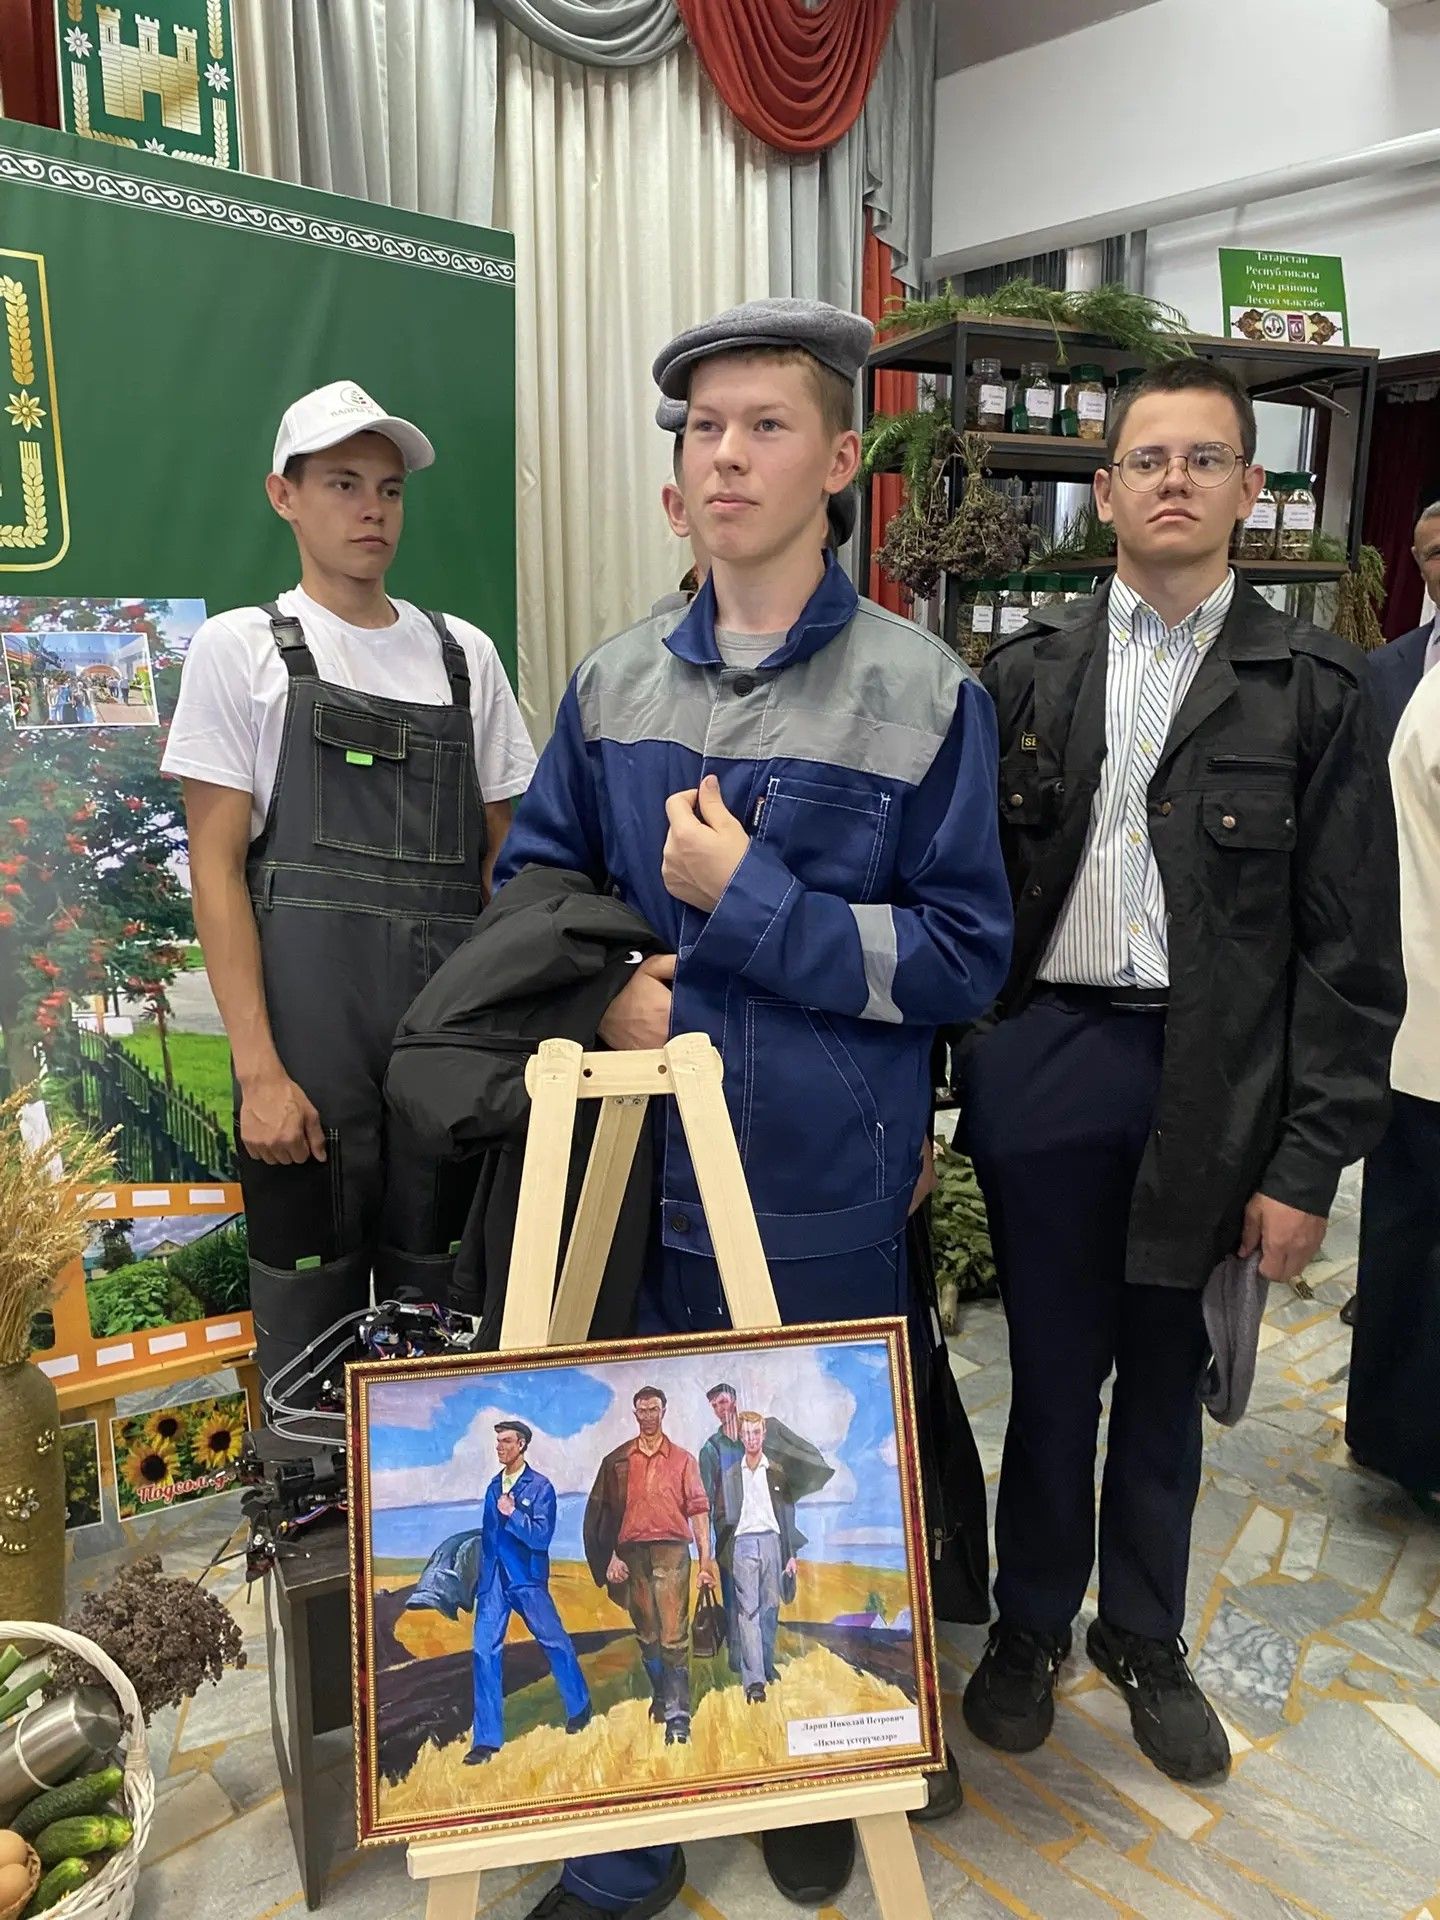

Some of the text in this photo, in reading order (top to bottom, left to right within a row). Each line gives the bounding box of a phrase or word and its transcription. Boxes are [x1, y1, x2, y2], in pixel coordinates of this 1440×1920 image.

[1256, 251, 1308, 265] Татарстан
[1245, 264, 1320, 280] Республикасы
[1249, 280, 1276, 292] Арча
[1244, 294, 1280, 305] Лесхоз
[830, 1716, 865, 1729] Николай
[866, 1714, 905, 1726] Петрович
